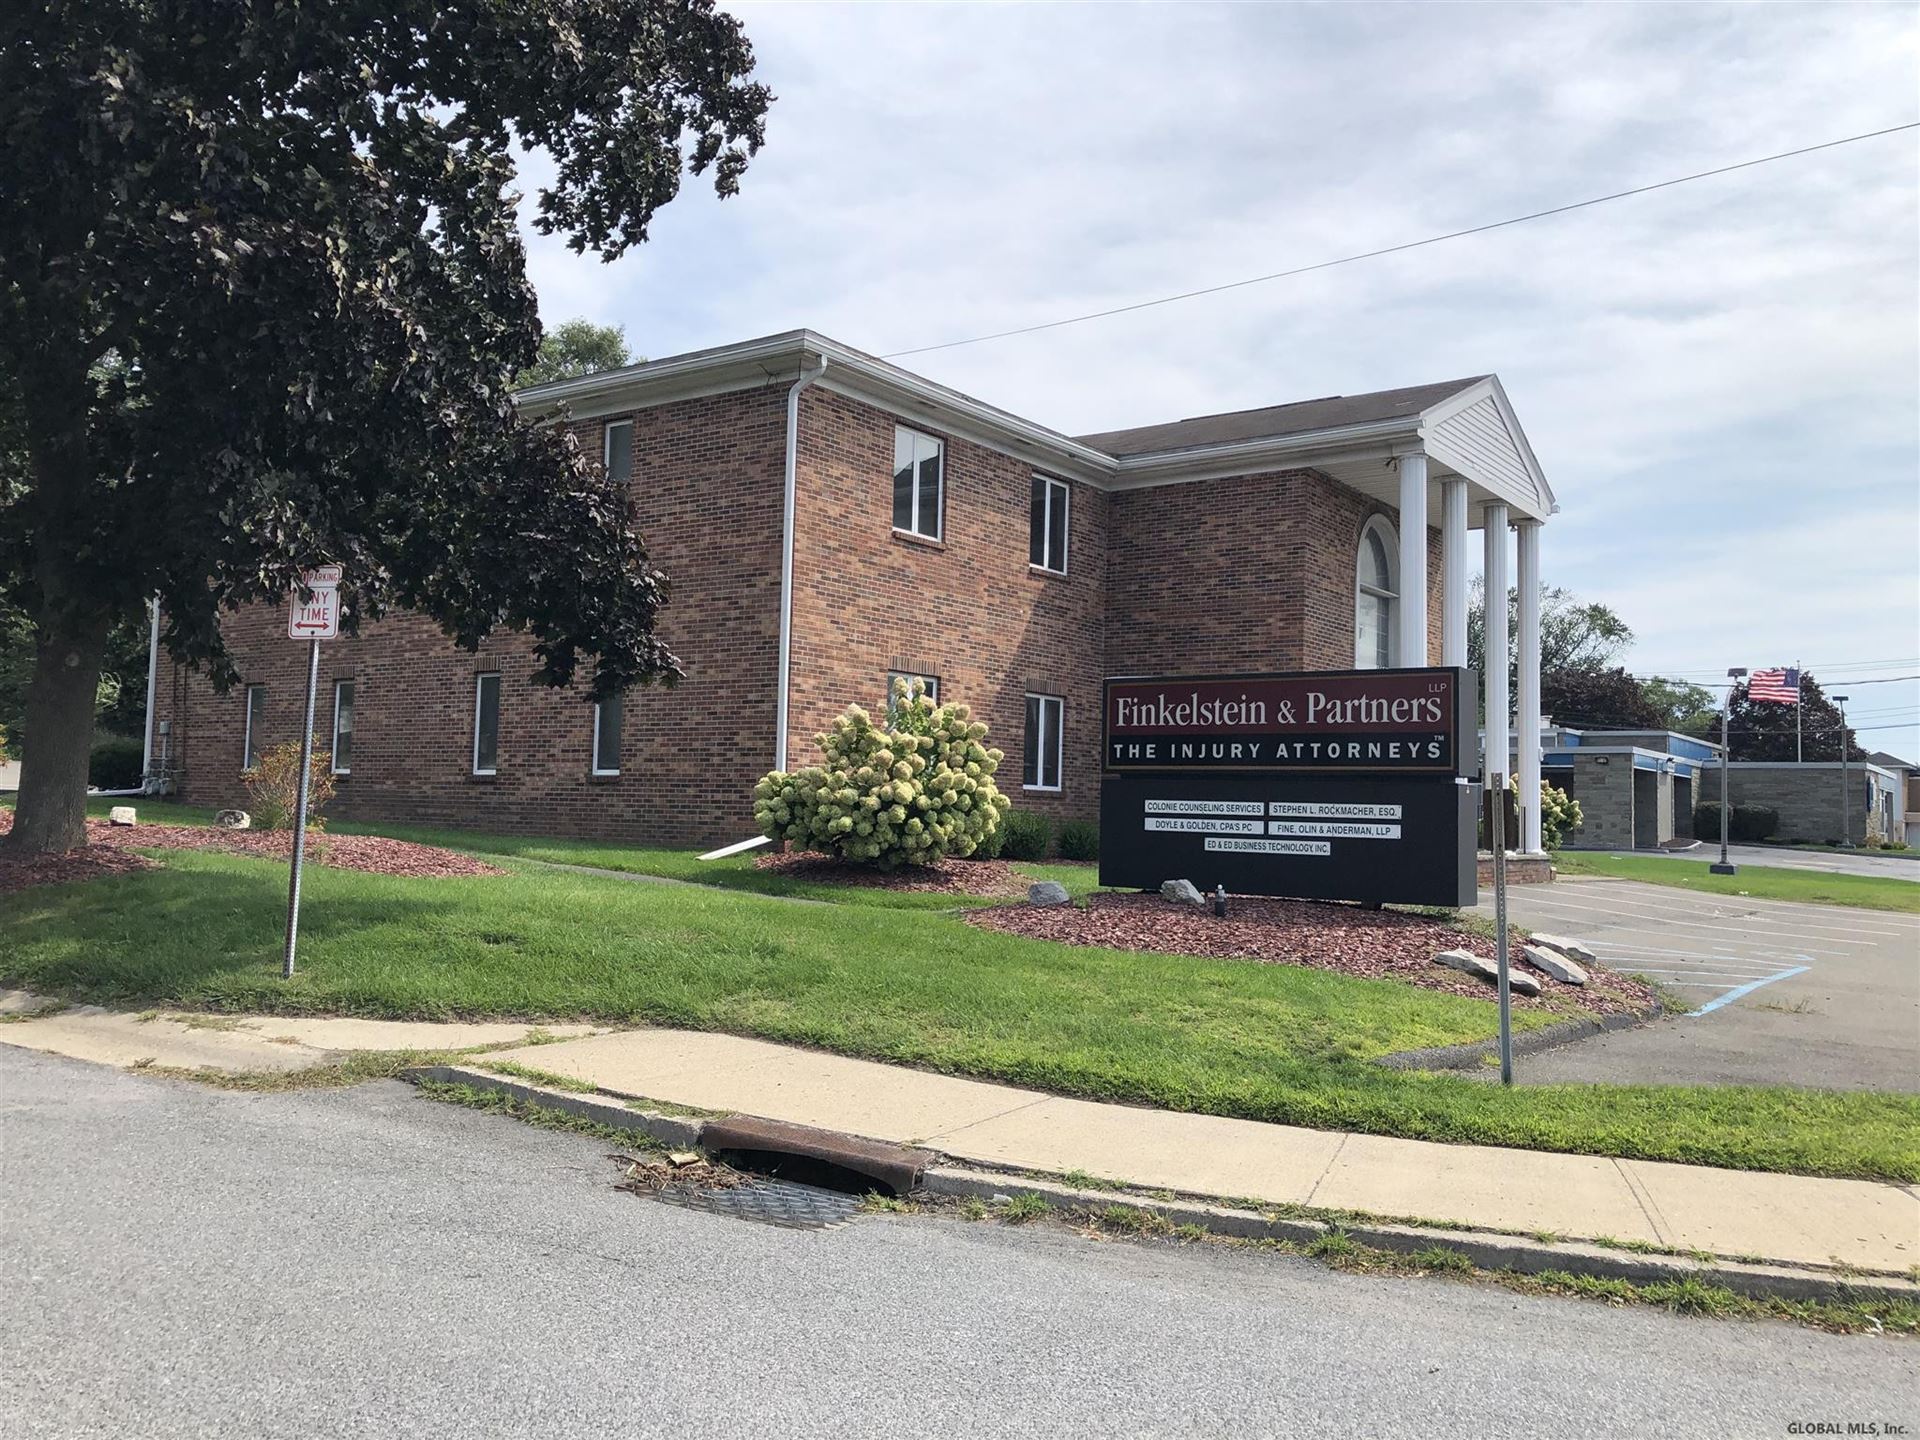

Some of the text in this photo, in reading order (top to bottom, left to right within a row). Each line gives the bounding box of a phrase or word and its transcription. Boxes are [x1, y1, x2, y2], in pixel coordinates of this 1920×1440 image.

[309, 572, 338, 582] PARKING
[299, 607, 330, 621] TIME
[1428, 683, 1447, 693] LLP
[1115, 691, 1442, 727] Finkelstein & Partners
[1113, 741, 1441, 759] THE INJURY ATTORNEYS
[1147, 802, 1262, 813] COLONIE COUNSELING SERVICES
[1273, 804, 1398, 817] STEPHEN L. ROCKMACHER, ESQ.
[1155, 820, 1253, 832] DOYLE & GOLDEN, CPA'S PC
[1277, 824, 1391, 836] FINE, OLIN & ANDERMAN, LLP
[1207, 840, 1217, 849] ED
[1217, 841, 1222, 849] &
[1223, 841, 1233, 850] ED
[1234, 841, 1267, 851] BUSINESS
